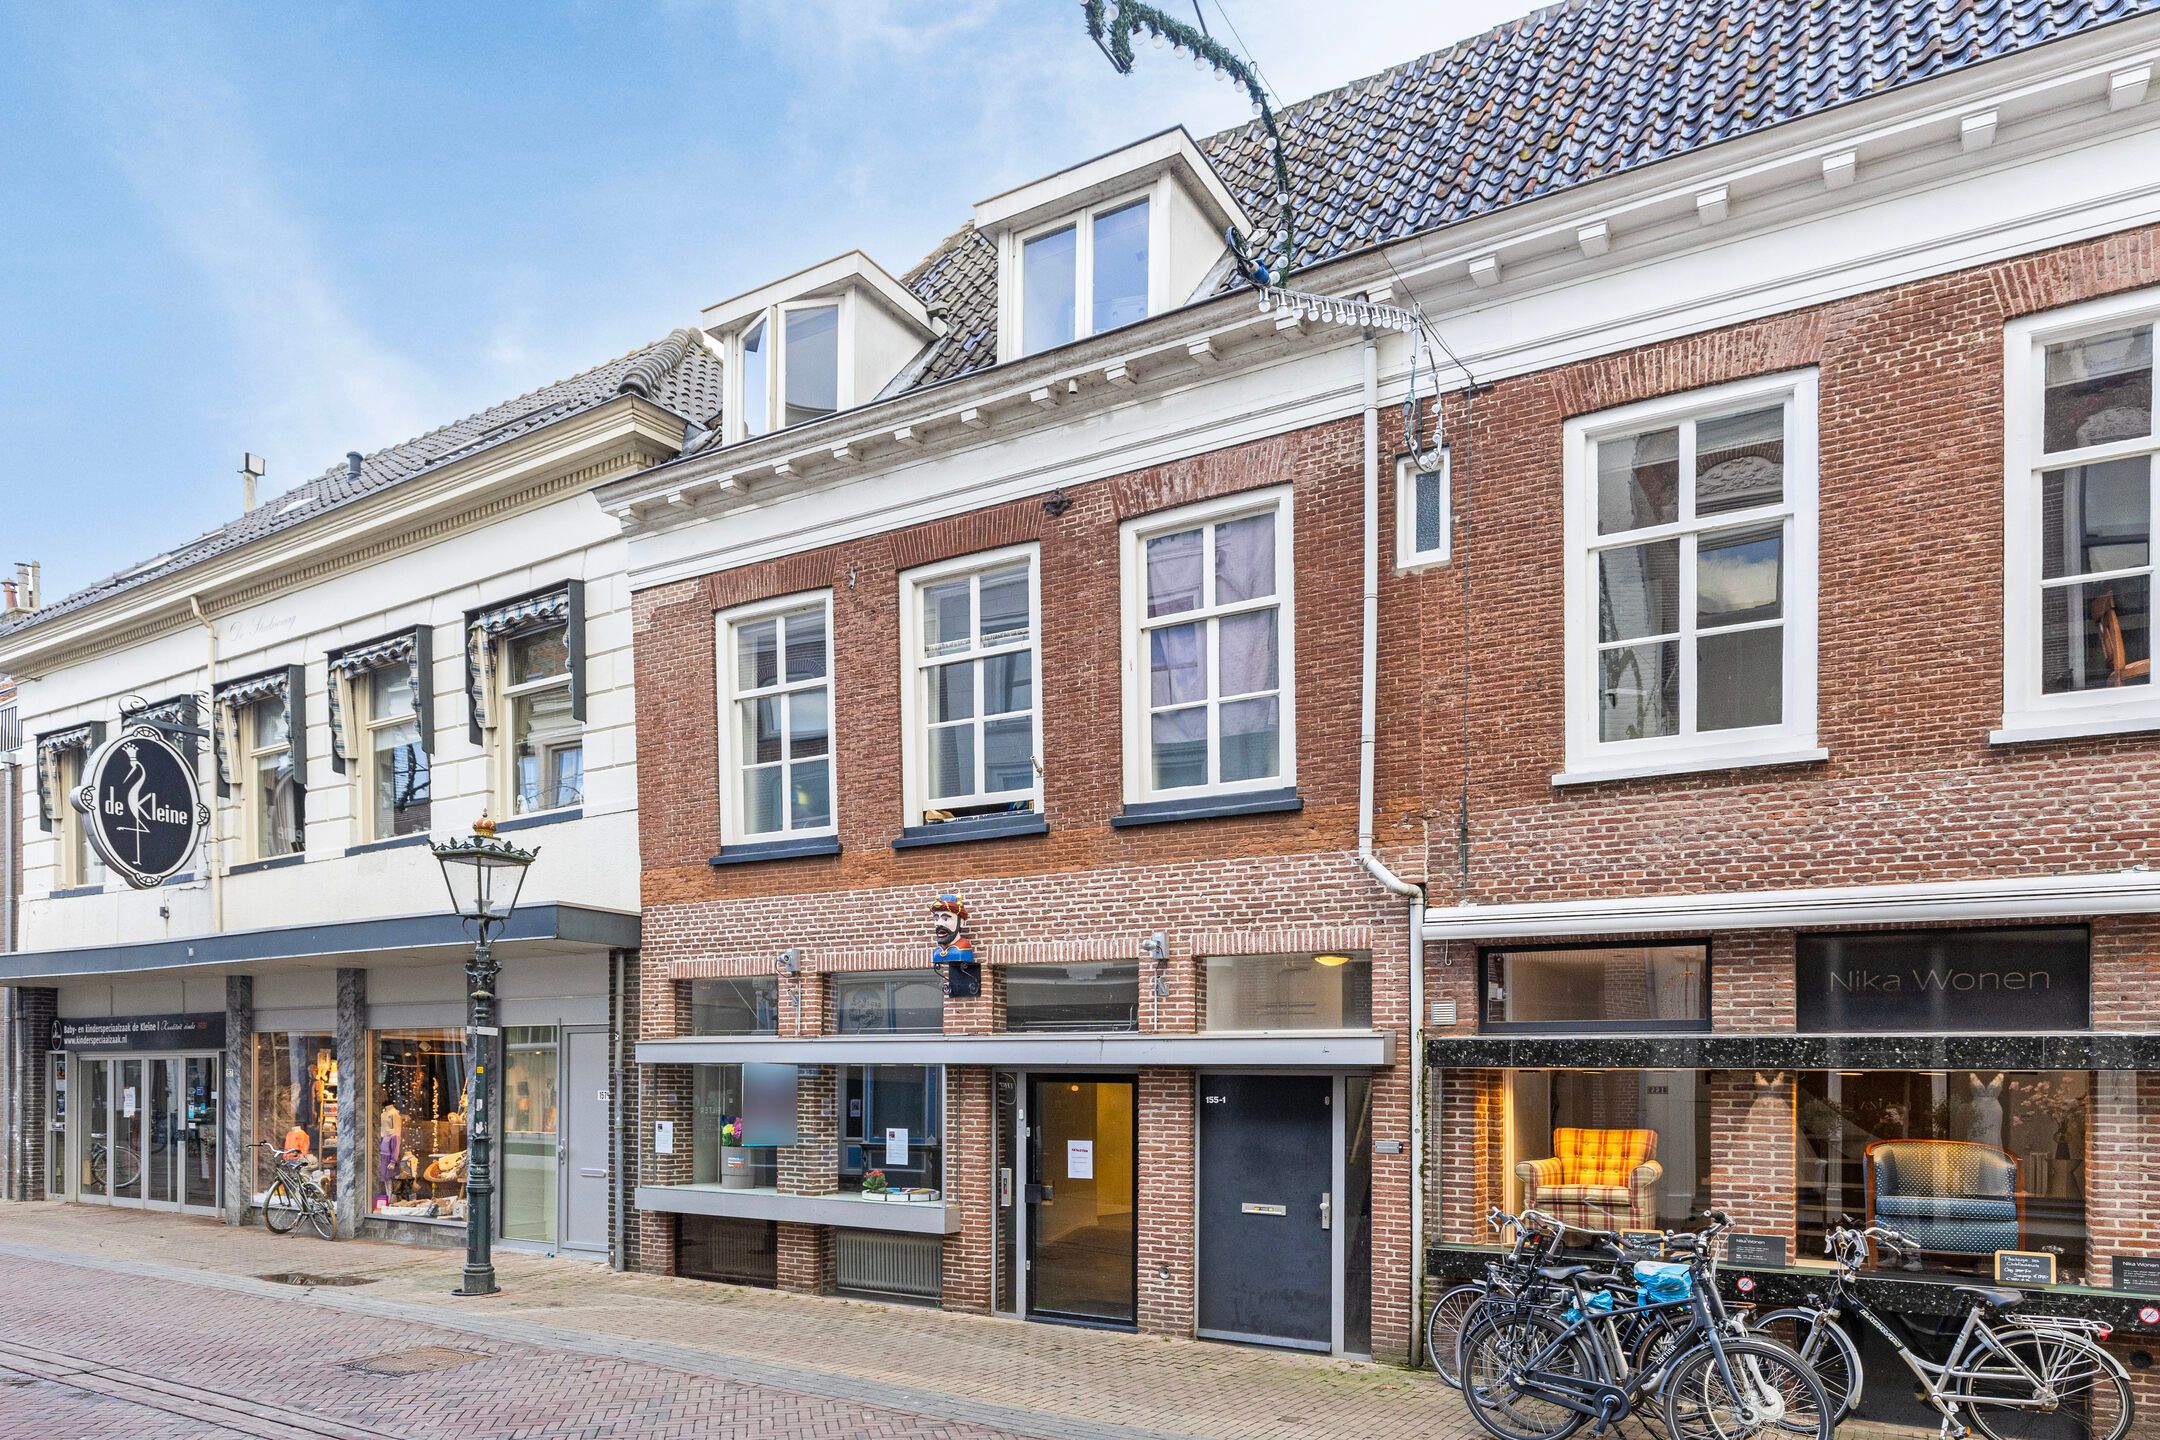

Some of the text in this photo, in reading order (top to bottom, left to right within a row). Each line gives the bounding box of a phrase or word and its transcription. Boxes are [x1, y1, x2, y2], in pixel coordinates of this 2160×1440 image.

[105, 786, 124, 816] de
[1830, 968, 2050, 992] Nika Wonen
[64, 1025, 77, 1035] Baby-
[85, 1022, 131, 1034] kinderspeciaalzaak
[132, 1022, 139, 1032] de
[140, 1021, 156, 1031] Kleine
[64, 1034, 127, 1046] www.kinderspeciaalzaak.nl
[1206, 1096, 1226, 1104] 155-1
